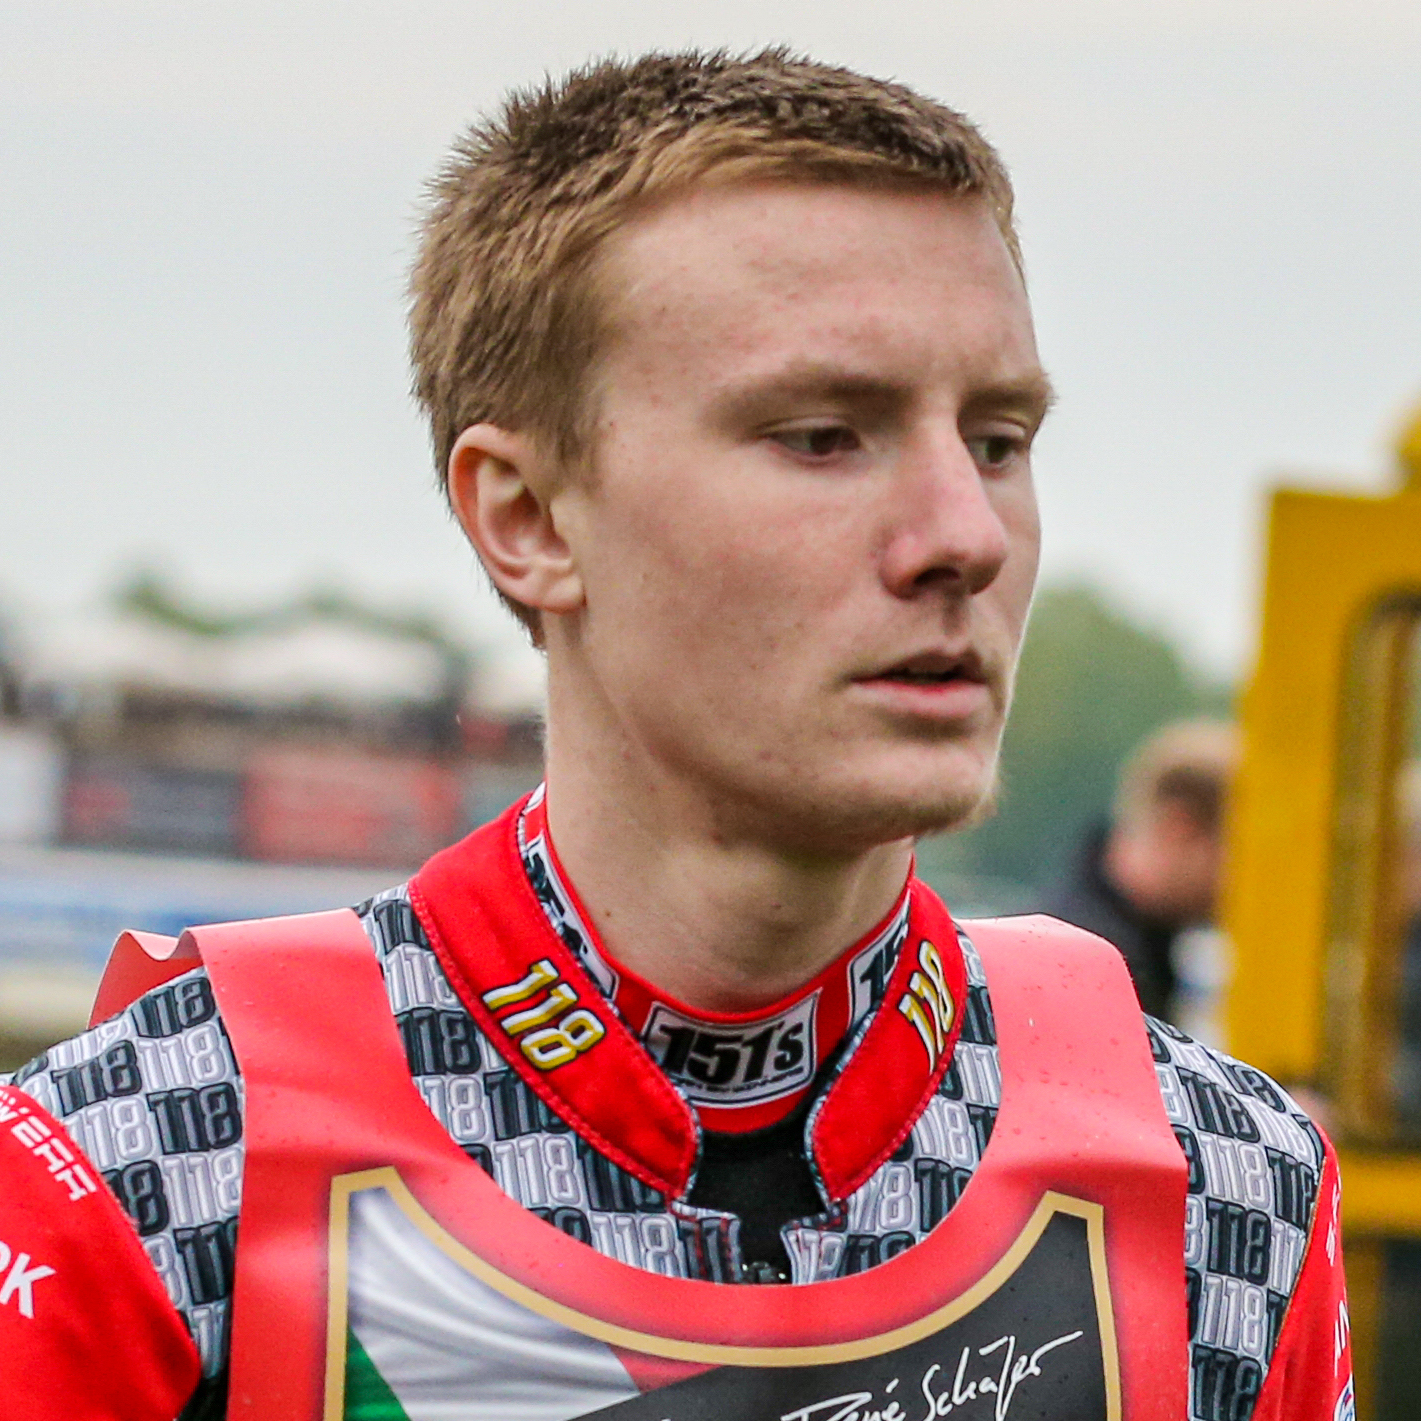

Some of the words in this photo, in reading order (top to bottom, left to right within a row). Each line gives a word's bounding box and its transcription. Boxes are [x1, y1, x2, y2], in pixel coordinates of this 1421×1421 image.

[482, 959, 606, 1070] 118
[659, 1021, 805, 1085] 151's
[51, 1039, 143, 1115] 118
[137, 1022, 232, 1092] 118
[147, 1082, 243, 1155] 118
[1198, 1132, 1272, 1210] 118
[1205, 1196, 1272, 1287] 118
[1201, 1274, 1267, 1357] 118
